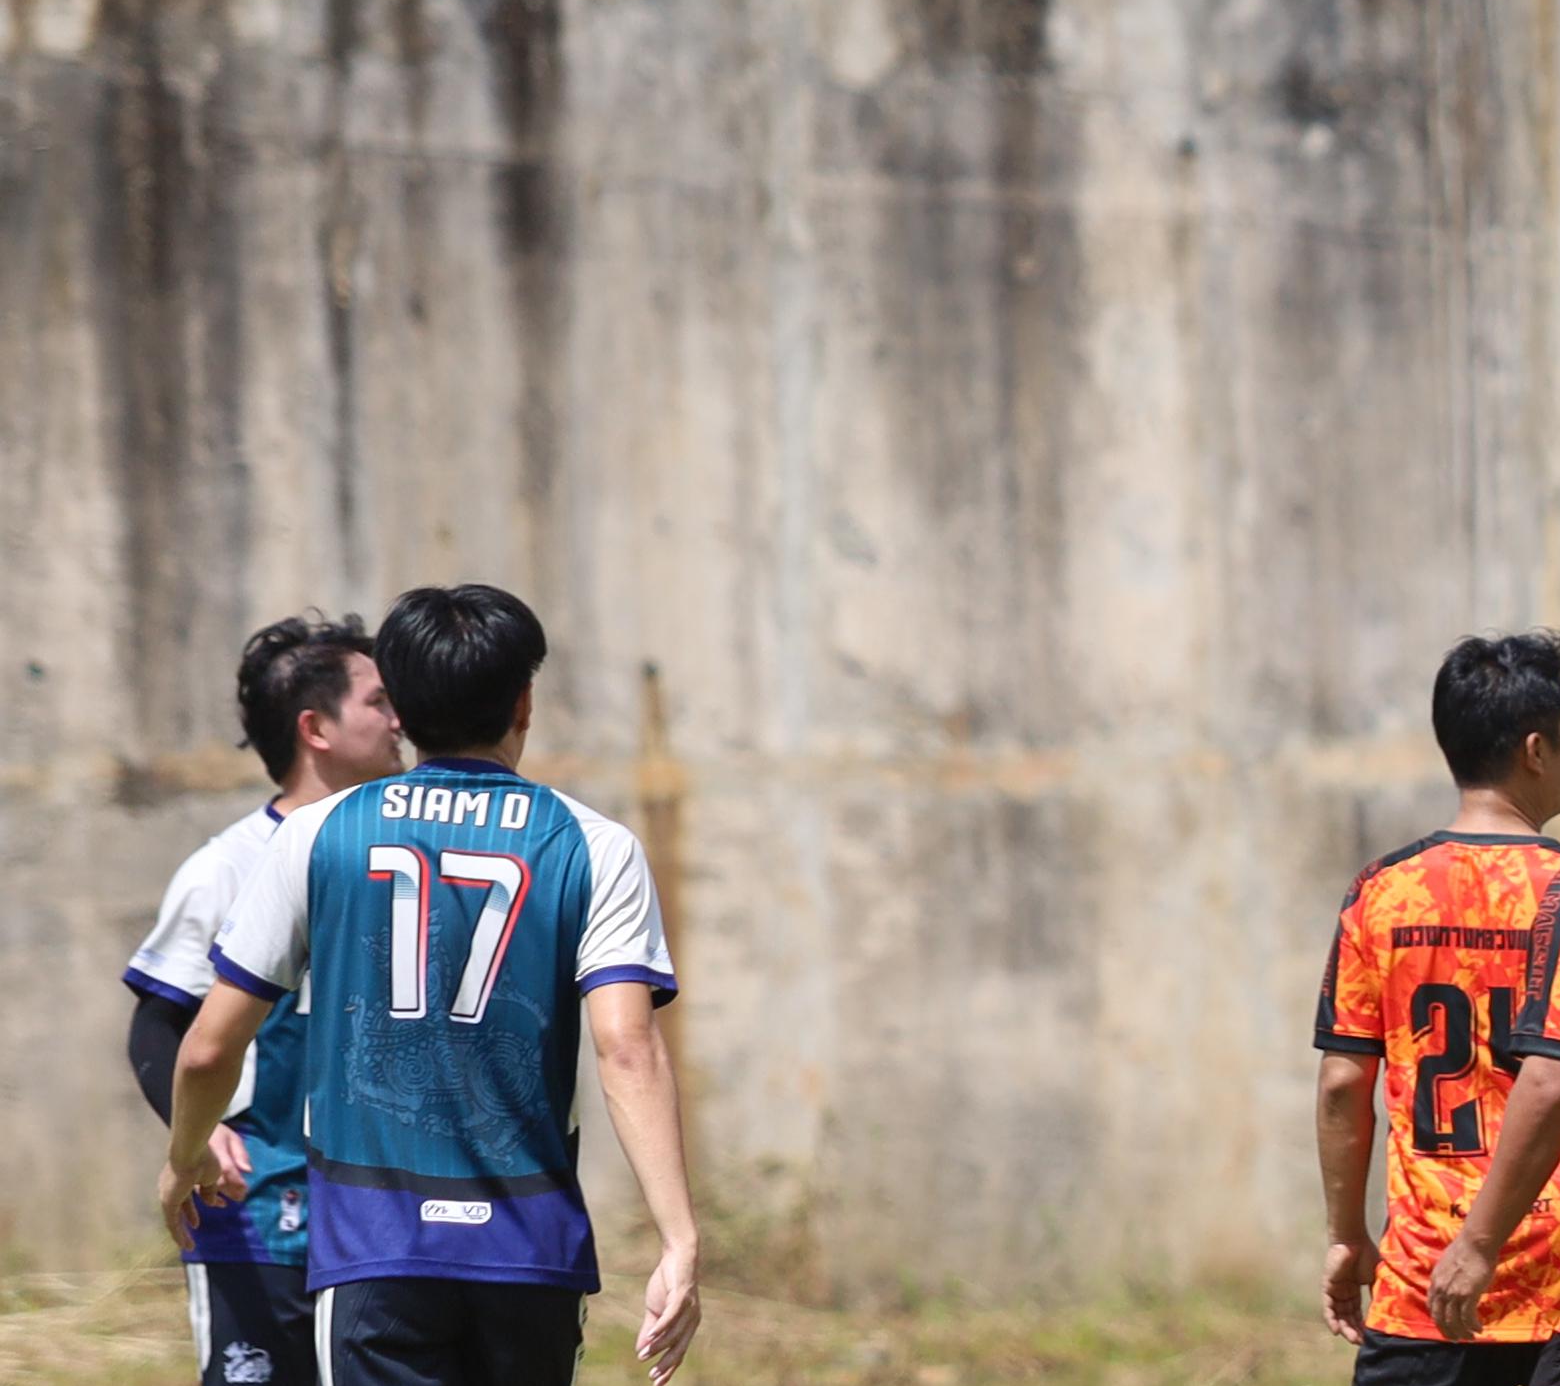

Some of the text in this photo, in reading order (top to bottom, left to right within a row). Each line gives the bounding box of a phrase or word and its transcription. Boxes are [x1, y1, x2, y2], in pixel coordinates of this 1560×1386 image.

[382, 784, 530, 829] SIAM D
[369, 845, 532, 1025] 17
